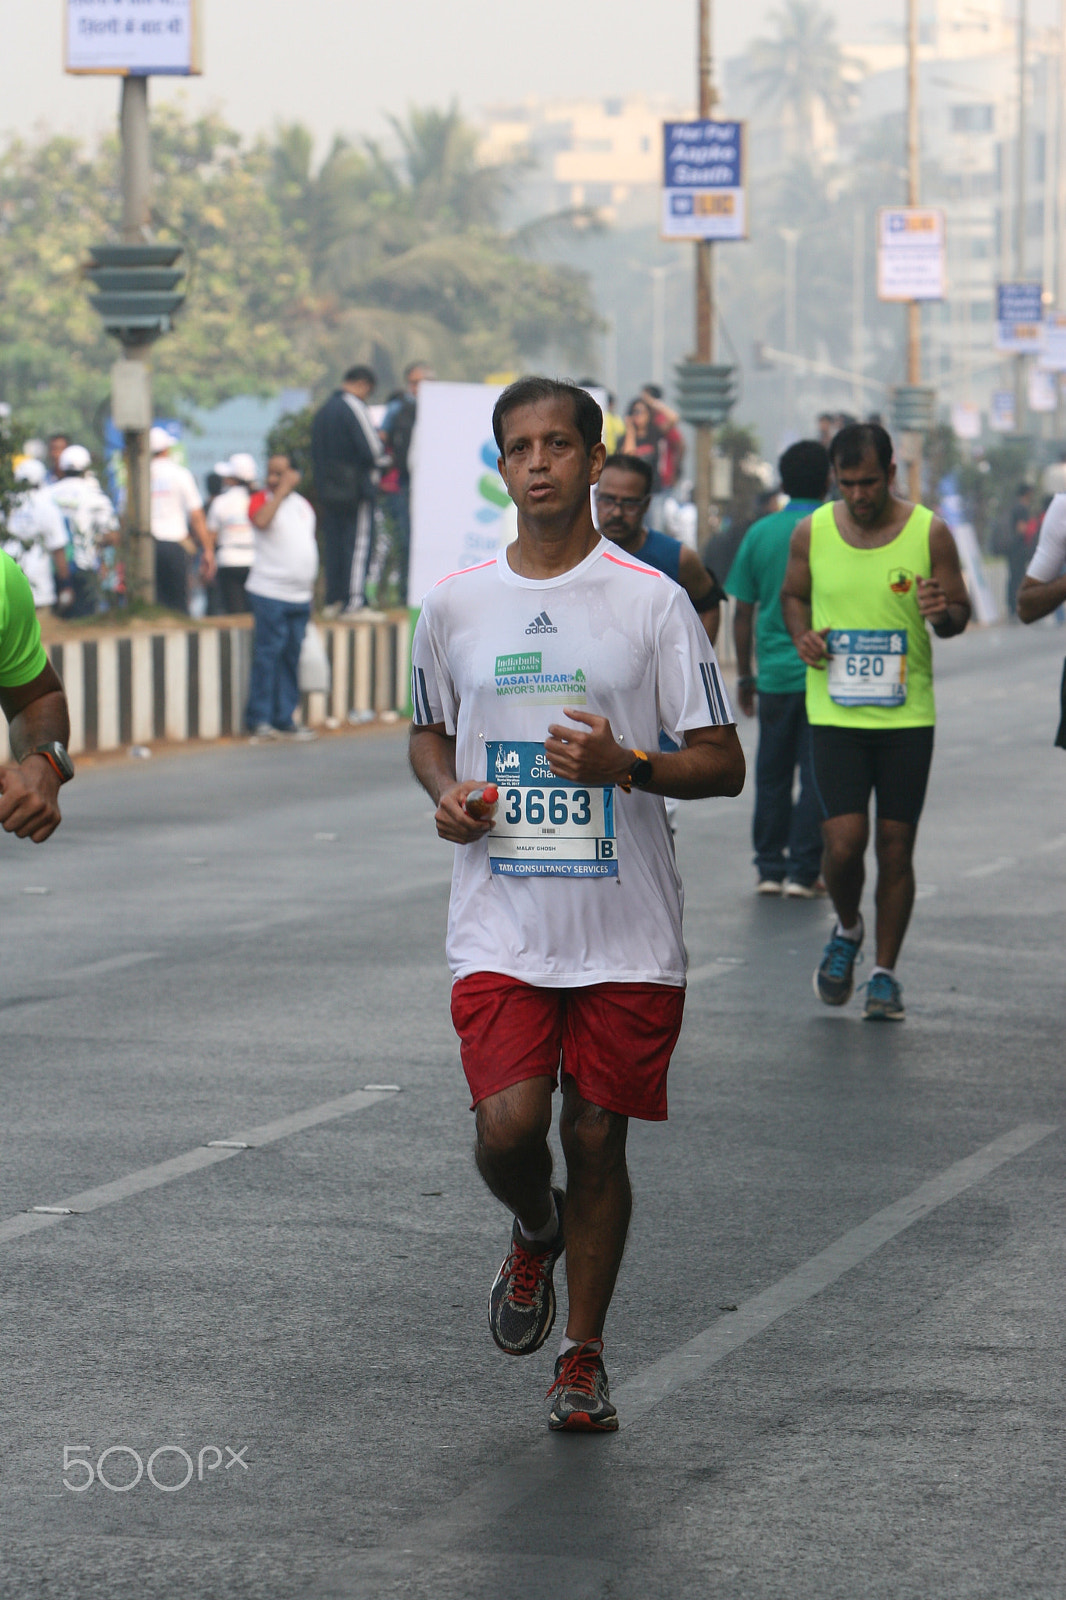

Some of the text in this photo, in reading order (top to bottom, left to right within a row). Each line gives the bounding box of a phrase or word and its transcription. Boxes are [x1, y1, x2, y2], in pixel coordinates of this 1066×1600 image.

[670, 143, 737, 165] Aapke
[674, 164, 734, 185] Saath
[525, 625, 558, 635] adidas
[497, 656, 540, 667] Indiabulls
[846, 656, 884, 677] 620
[495, 674, 568, 686] VASAI-VIRAR
[496, 683, 586, 696] MAYOR'S MARATHON
[505, 788, 591, 825] 3663
[601, 840, 614, 858] B
[498, 863, 608, 874] TATA CONSULTANCY SERVICES
